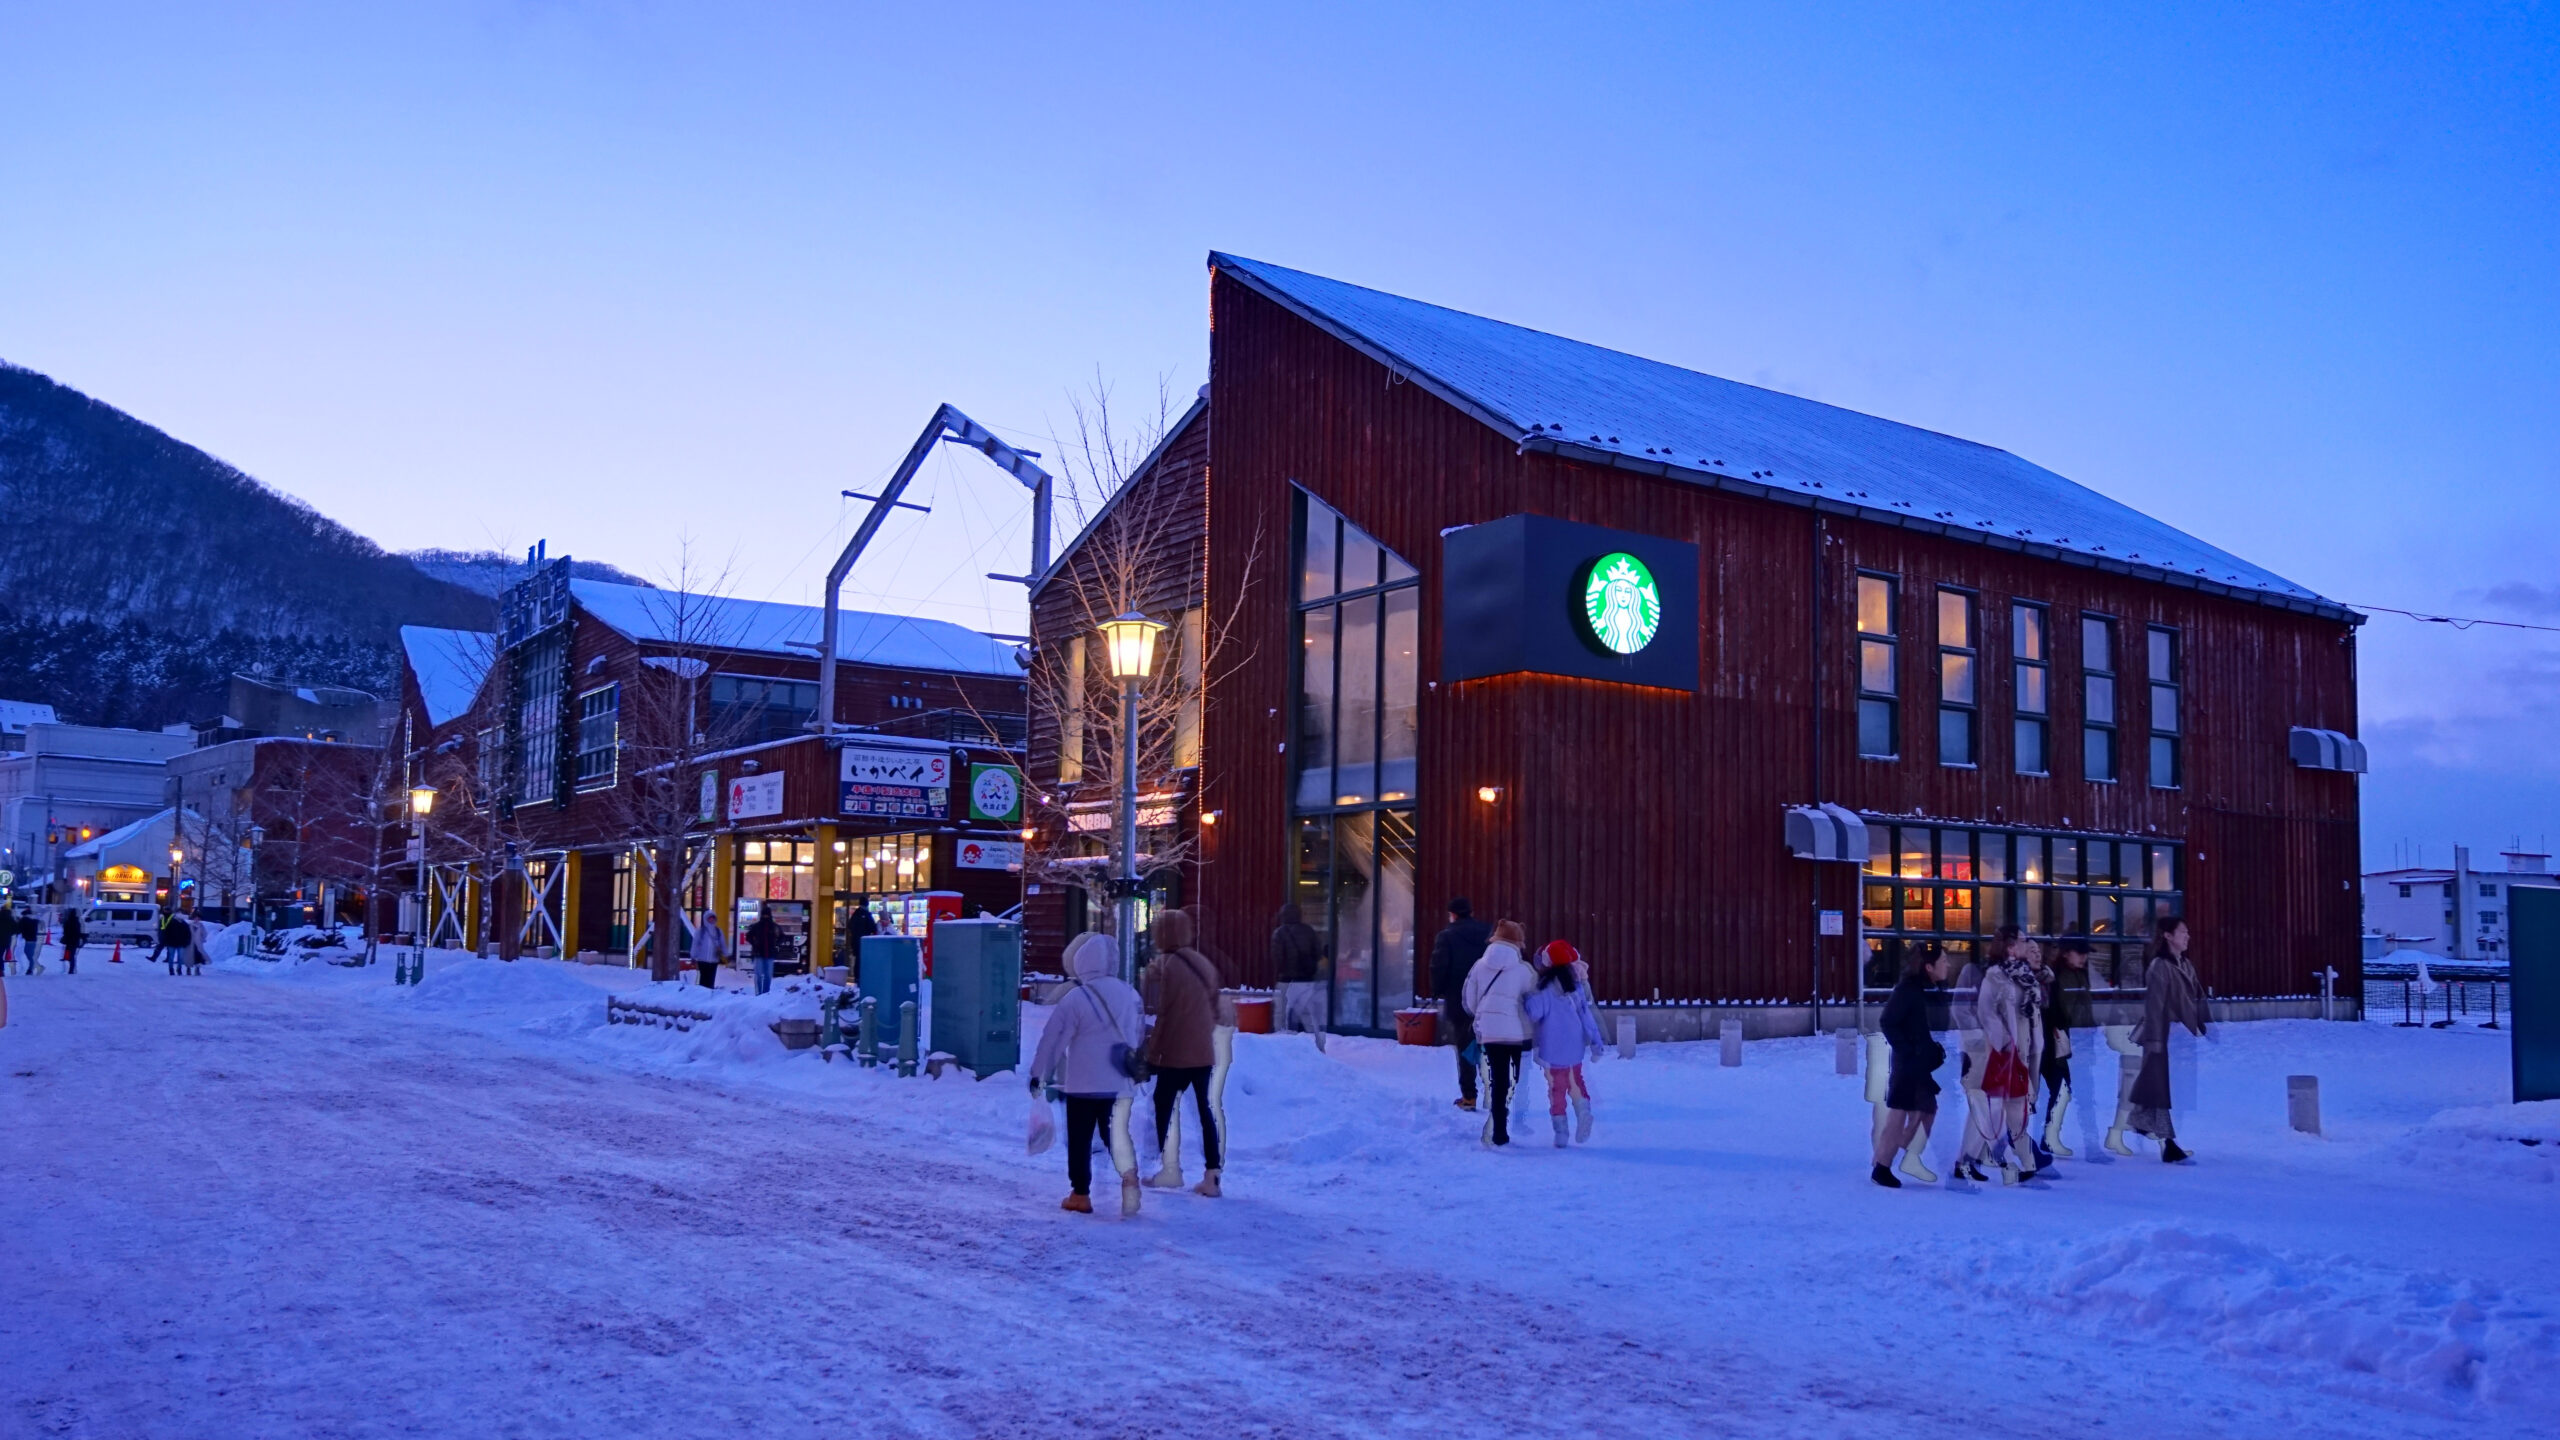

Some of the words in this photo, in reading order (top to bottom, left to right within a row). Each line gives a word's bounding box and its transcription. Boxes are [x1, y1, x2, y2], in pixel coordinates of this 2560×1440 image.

[851, 764, 924, 783] いかベイ
[1067, 813, 1113, 832] STARBU
